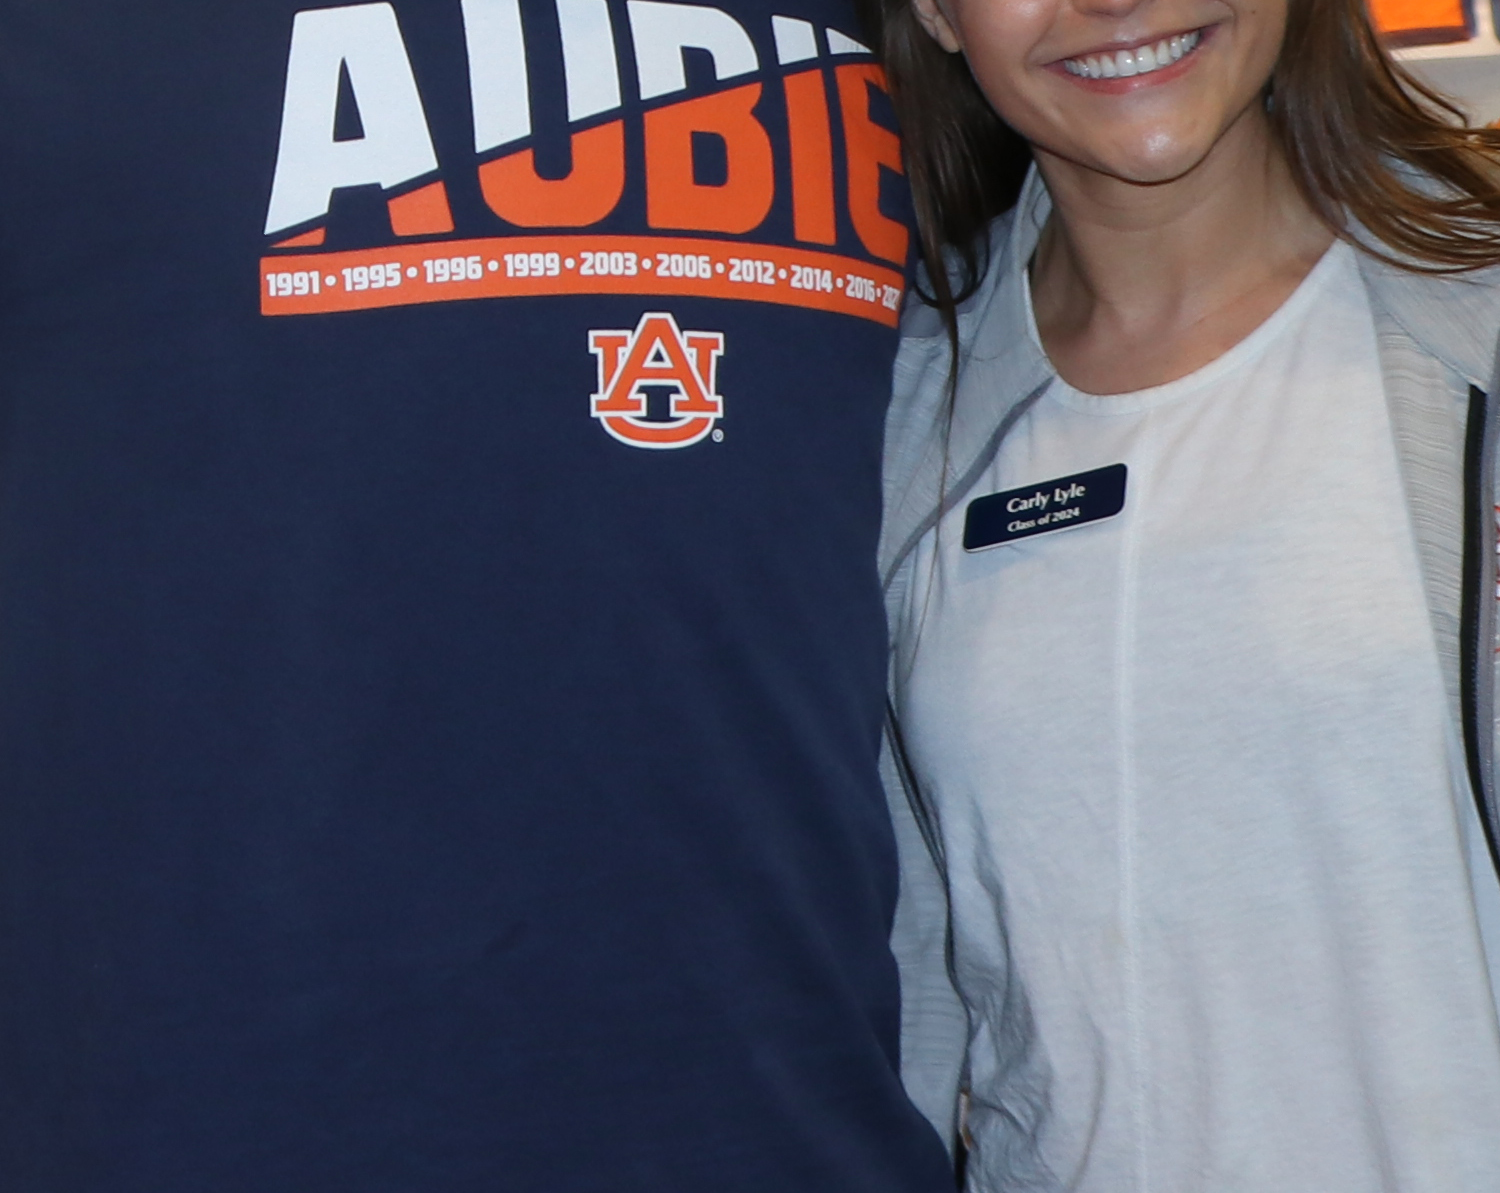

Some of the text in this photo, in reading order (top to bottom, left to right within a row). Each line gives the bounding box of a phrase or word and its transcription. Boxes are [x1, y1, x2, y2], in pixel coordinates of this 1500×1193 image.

[266, 269, 320, 297] 1991
[341, 262, 402, 292] 1995
[422, 255, 483, 284] 1996
[503, 252, 561, 278] 1999
[579, 251, 638, 277] 2003
[655, 253, 712, 280] 2006
[728, 258, 776, 285] 2012
[790, 264, 834, 293] 2014
[845, 273, 876, 303] 2016
[1006, 483, 1086, 511] Carly Lyle
[1006, 507, 1080, 533] Class of 2024
